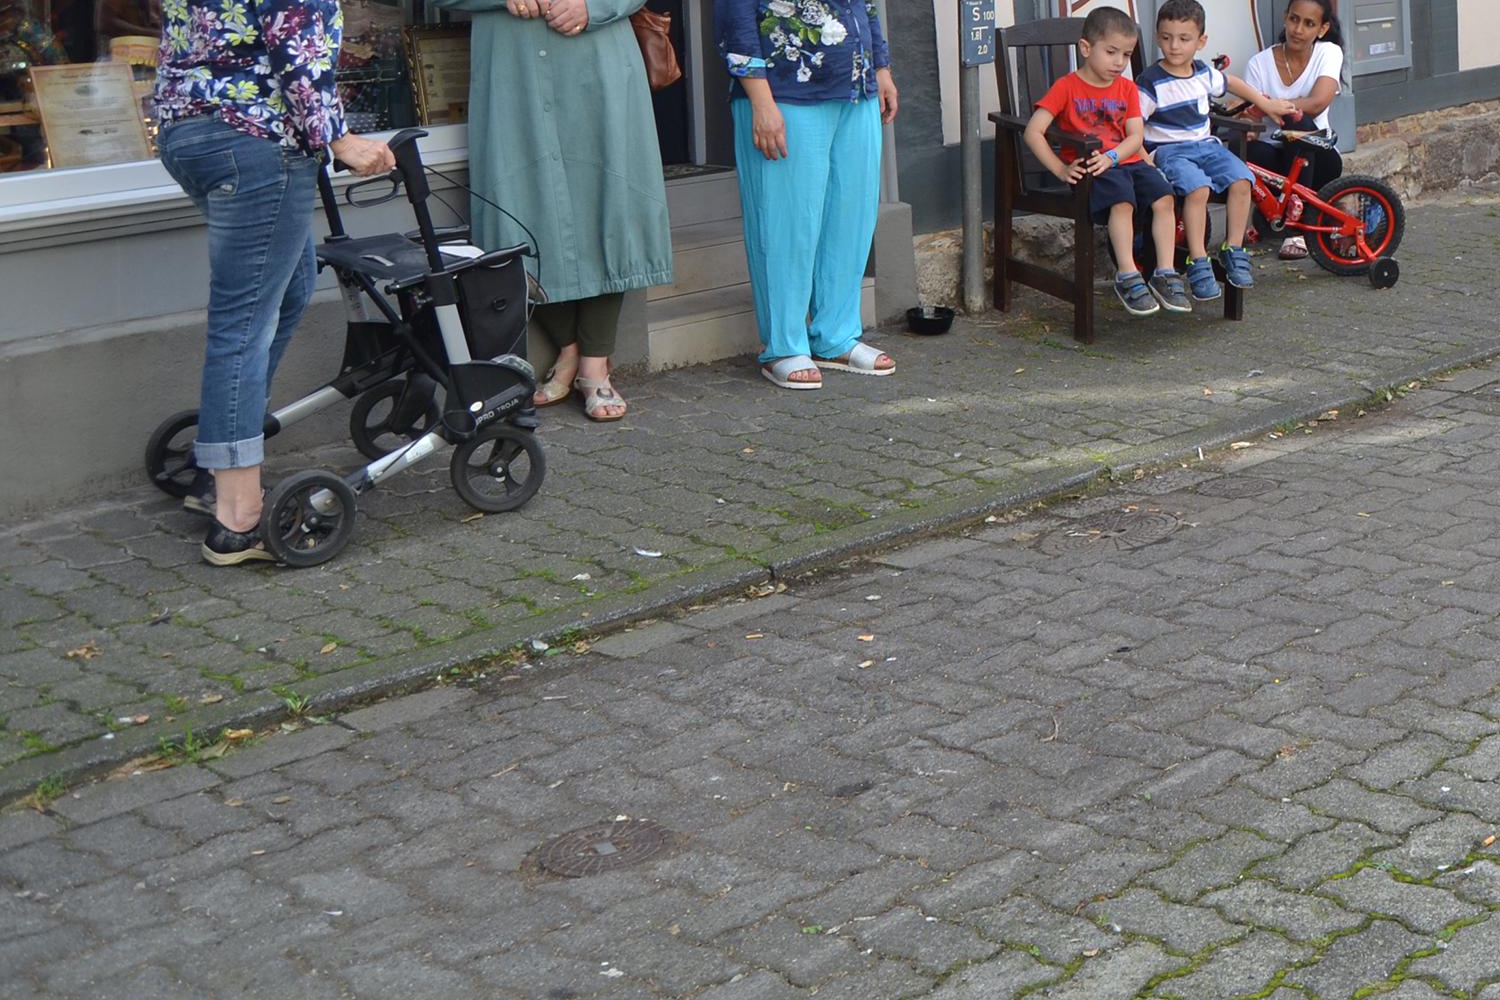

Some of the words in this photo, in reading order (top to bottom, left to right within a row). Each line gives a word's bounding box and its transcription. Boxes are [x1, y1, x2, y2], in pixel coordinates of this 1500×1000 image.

[972, 6, 980, 21] S
[983, 10, 995, 21] 100
[496, 398, 519, 413] TROJA
